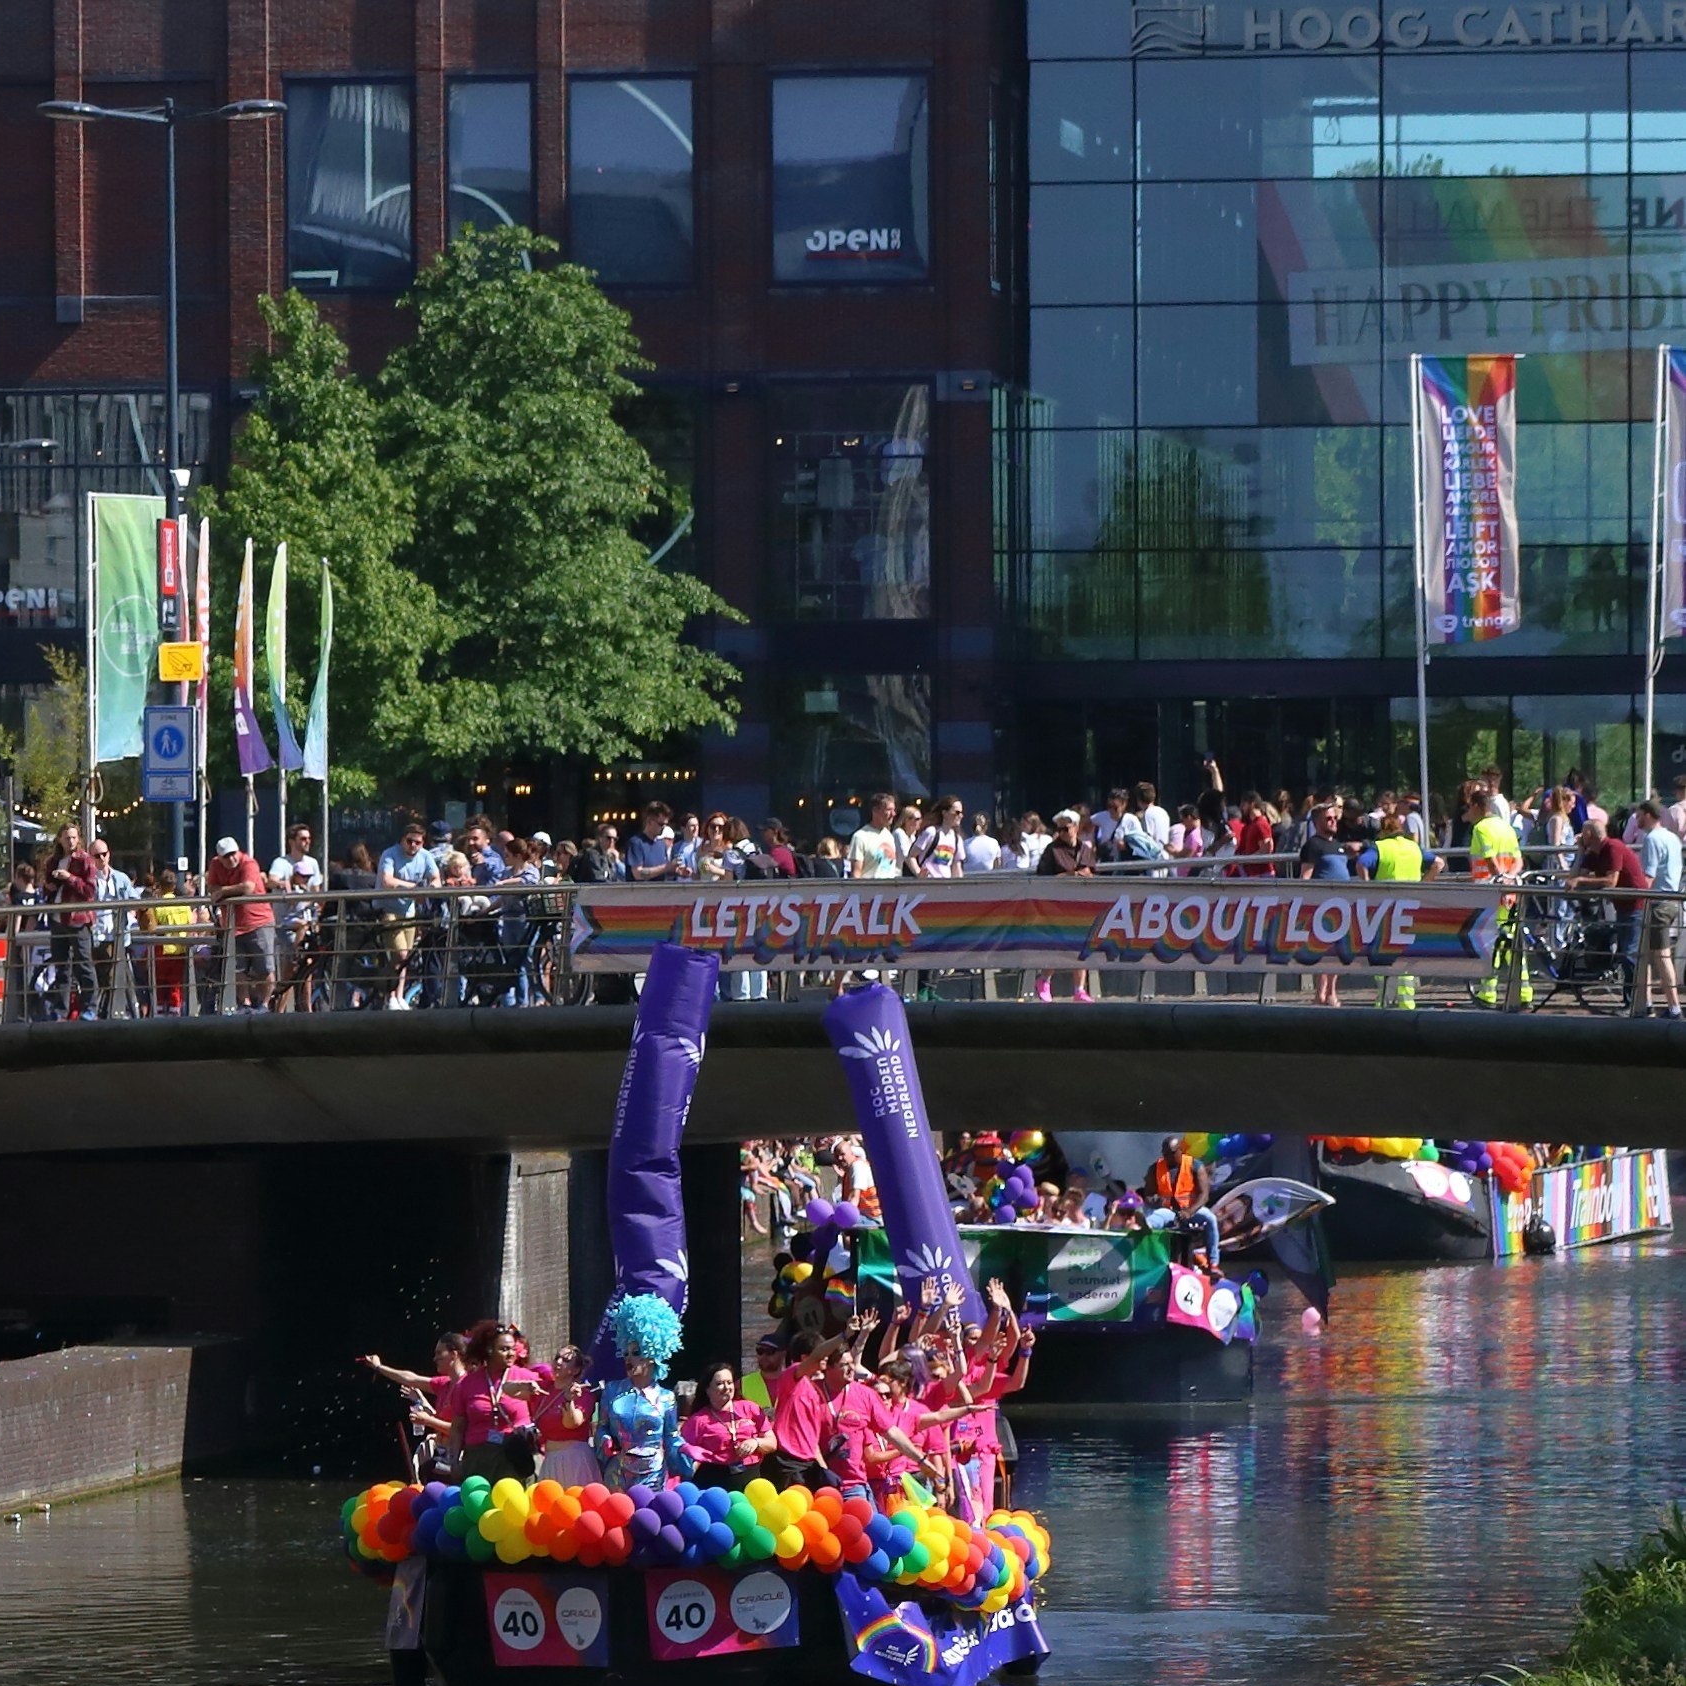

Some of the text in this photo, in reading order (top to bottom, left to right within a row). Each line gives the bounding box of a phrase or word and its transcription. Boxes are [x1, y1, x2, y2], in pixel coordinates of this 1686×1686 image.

[1243, 8, 1430, 50] HOOG
[1312, 277, 1510, 346] HAPPY
[1441, 405, 1495, 424] LOVE
[1443, 425, 1496, 440] LIEFDE
[1443, 441, 1496, 455] AMOUR
[1444, 472, 1497, 490] LIEBE
[1445, 490, 1498, 504] AMORE
[1445, 540, 1498, 556] AMOR
[814, 893, 927, 936] TALK
[1096, 894, 1422, 945] ABOUT LOVE
[877, 1056, 900, 1115] MIDDEN
[890, 1054, 919, 1139] NEDERLAND
[870, 1086, 885, 1118] ROC
[1067, 1288, 1119, 1300] anderen
[736, 1591, 785, 1605] ORACLE
[501, 1610, 539, 1637] 40
[560, 1608, 597, 1619] ORACLE
[664, 1602, 707, 1631] 40
